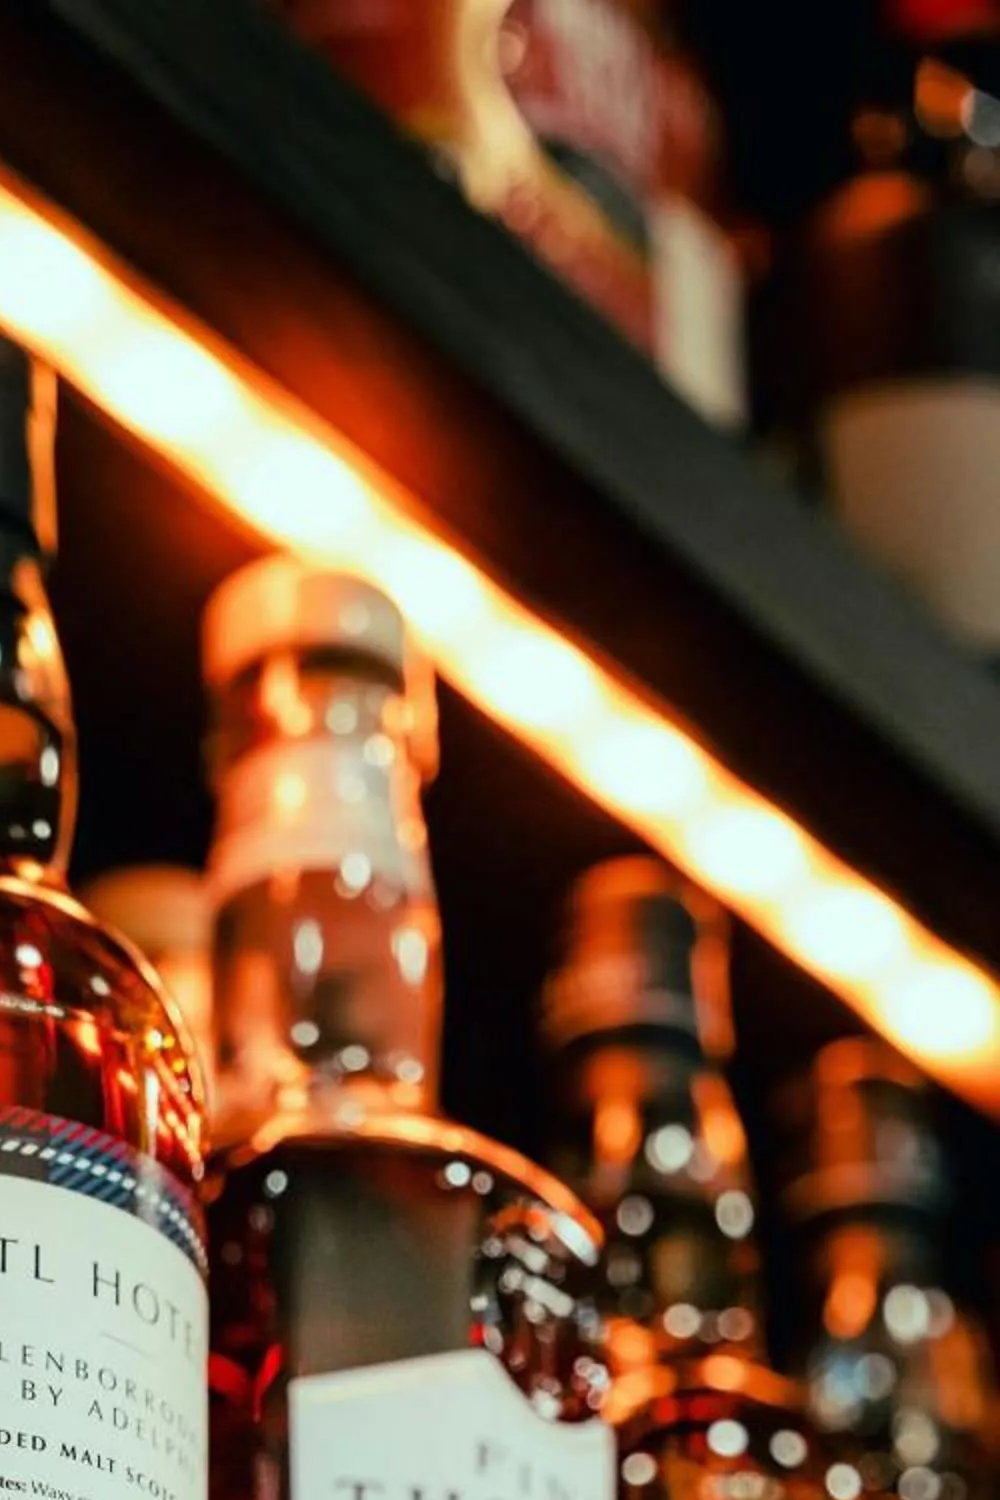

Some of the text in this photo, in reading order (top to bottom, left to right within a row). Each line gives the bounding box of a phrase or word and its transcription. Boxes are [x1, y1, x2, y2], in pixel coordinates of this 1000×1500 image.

[93, 1260, 200, 1366] HOTE
[21, 1380, 63, 1407] BY
[60, 1443, 116, 1473] MALT
